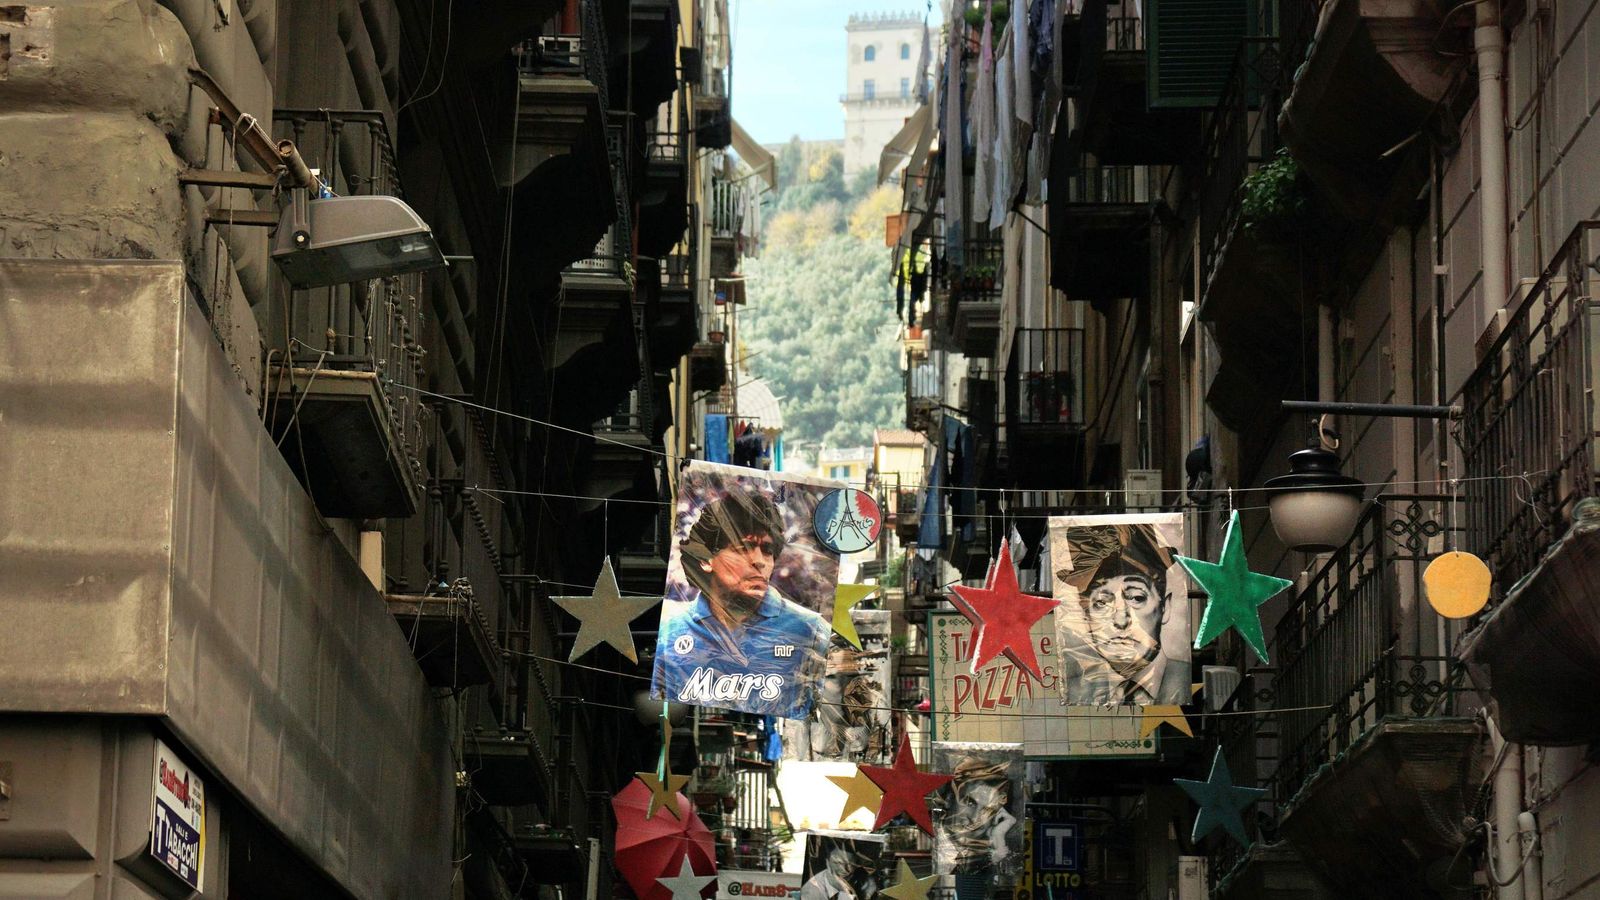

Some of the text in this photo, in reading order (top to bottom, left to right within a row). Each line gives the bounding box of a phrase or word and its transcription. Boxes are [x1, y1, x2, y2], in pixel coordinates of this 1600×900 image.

[678, 667, 784, 701] Mars
[165, 814, 199, 872] TABACCHI
[1045, 828, 1073, 865] T
[1036, 872, 1081, 888] LOTTO
